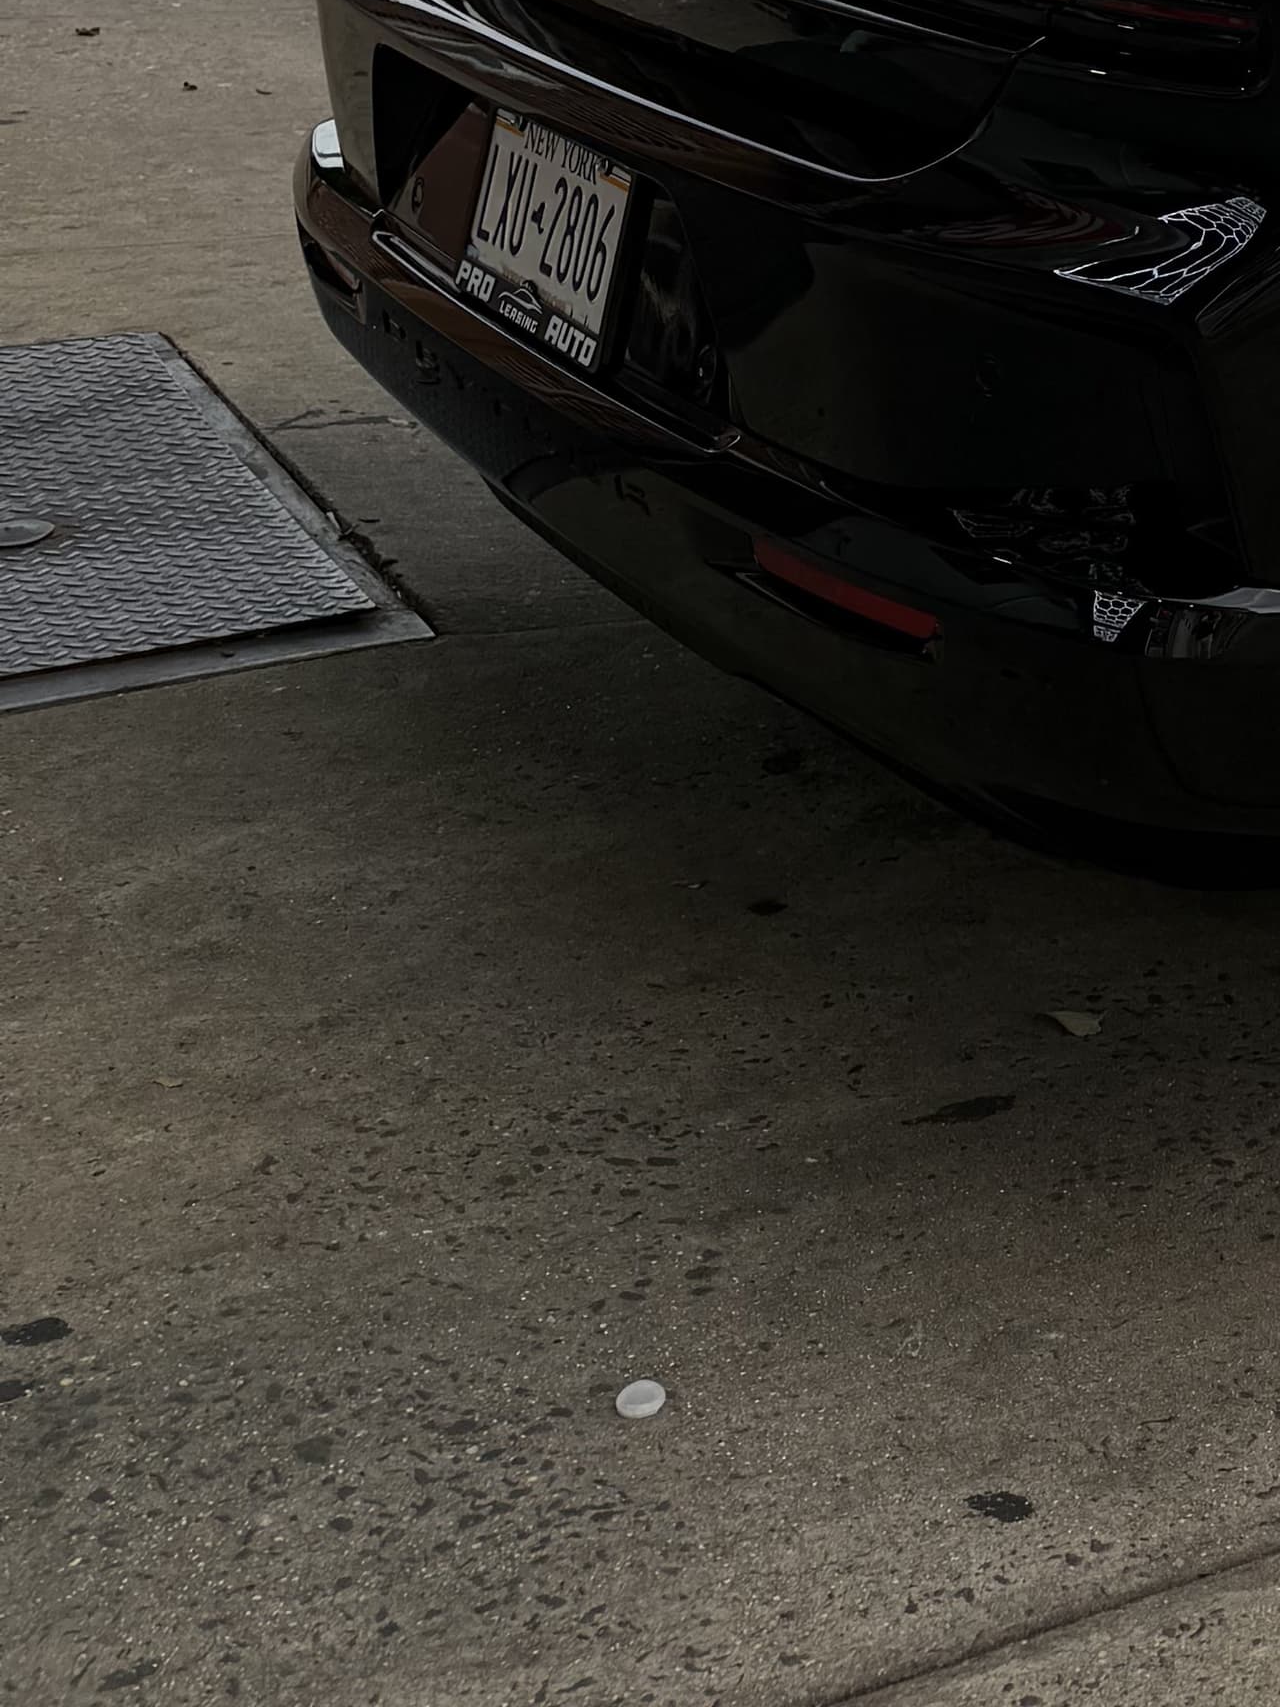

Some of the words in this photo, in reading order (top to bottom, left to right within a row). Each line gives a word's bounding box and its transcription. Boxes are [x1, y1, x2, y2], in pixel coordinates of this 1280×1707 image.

[523, 121, 561, 164] NEW
[561, 138, 601, 185] YORK
[476, 143, 538, 258] LXU
[539, 176, 616, 303] 2806
[454, 258, 497, 304] PRO
[498, 299, 540, 335] LEASING
[543, 314, 598, 369] AUTO
